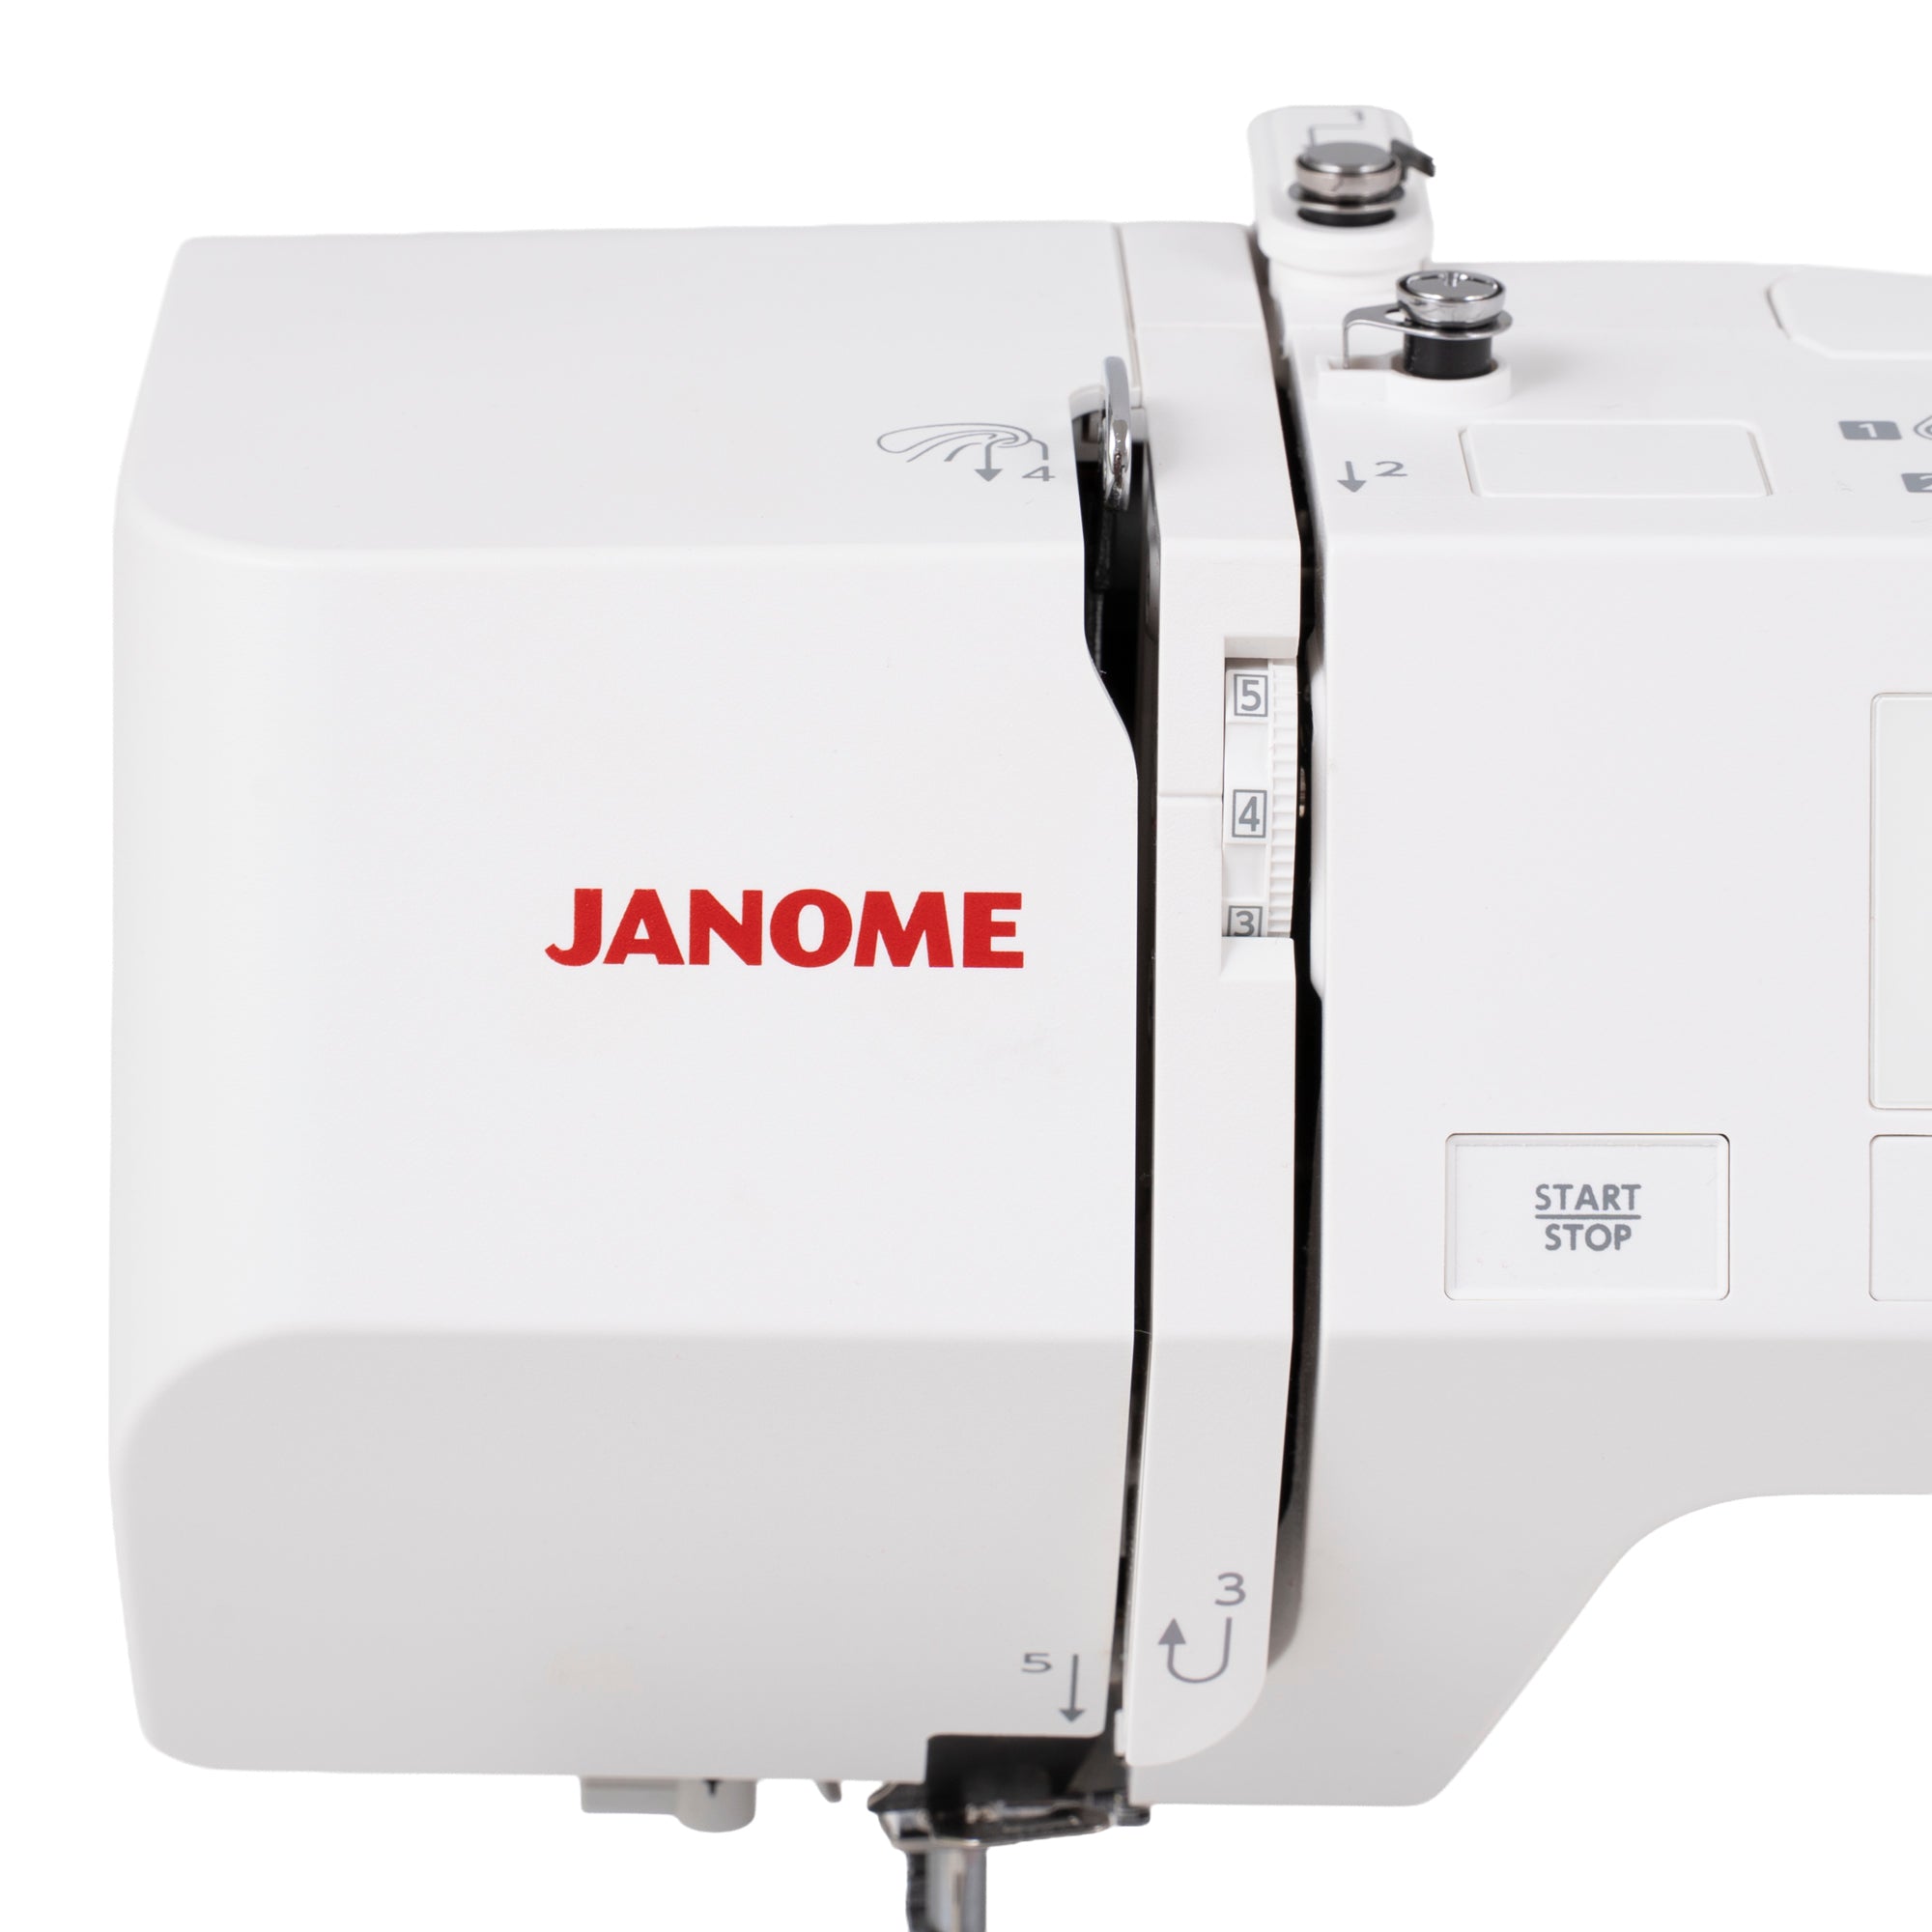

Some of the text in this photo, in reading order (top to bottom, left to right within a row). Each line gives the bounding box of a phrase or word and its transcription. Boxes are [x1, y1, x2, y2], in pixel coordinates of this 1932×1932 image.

[1021, 465, 1056, 482] 4
[1375, 461, 1407, 478] 2
[1240, 679, 1262, 712] 5
[1238, 795, 1261, 833] 4
[546, 889, 1024, 968] JANOME
[1234, 910, 1256, 936] 3
[1534, 1182, 1643, 1212] START
[1544, 1222, 1634, 1252] STOP
[1214, 1572, 1247, 1607] 3
[1021, 1653, 1052, 1674] 5
